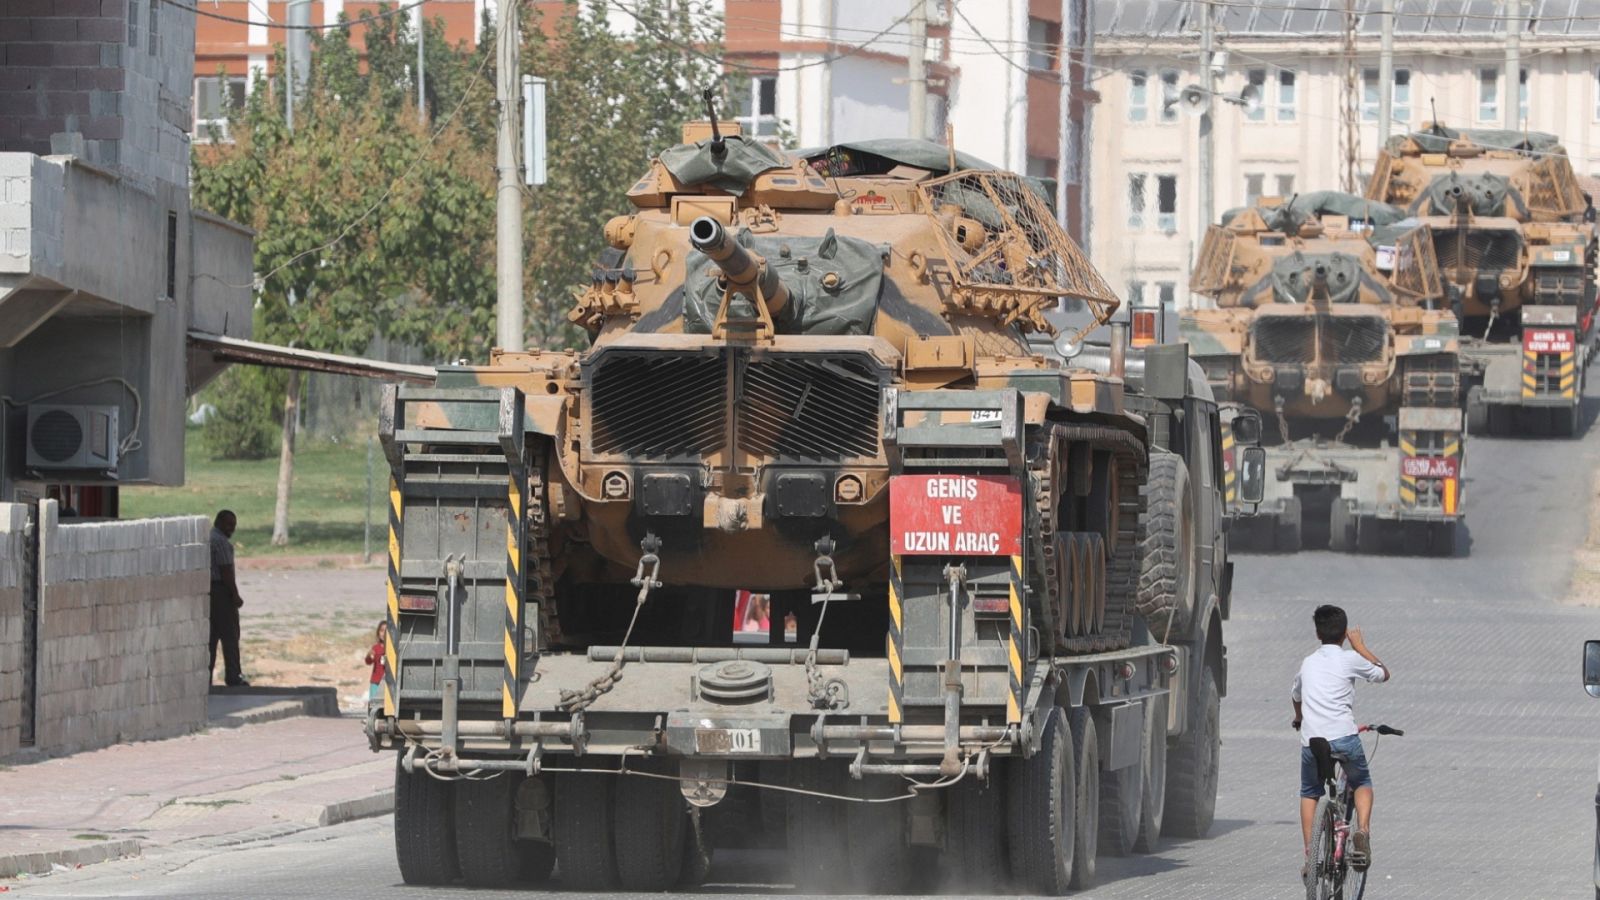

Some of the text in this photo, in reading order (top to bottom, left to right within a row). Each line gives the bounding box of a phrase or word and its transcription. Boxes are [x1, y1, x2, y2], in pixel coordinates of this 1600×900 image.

[927, 476, 977, 500] GENİŞ
[942, 505, 962, 524] VE
[904, 532, 999, 554] UZUN ARAÇ
